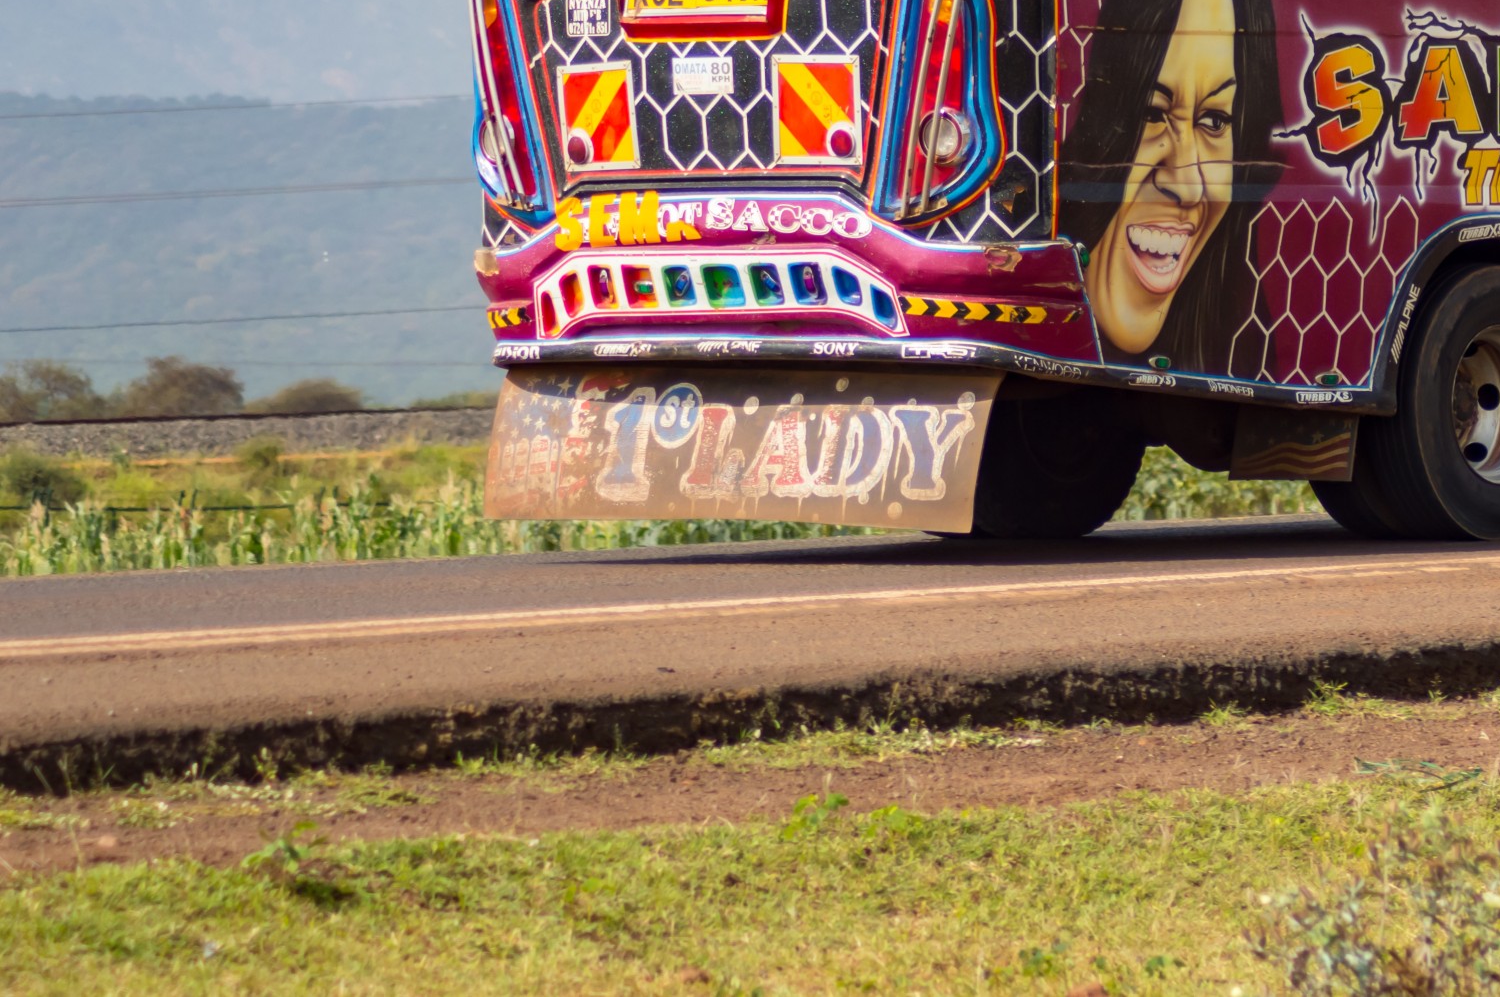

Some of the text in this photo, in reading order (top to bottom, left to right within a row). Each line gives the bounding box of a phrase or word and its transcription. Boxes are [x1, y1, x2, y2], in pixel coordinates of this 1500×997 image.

[675, 62, 730, 74] OMATA 80
[705, 197, 872, 239] SACCO
[813, 342, 859, 356] SONY
[680, 401, 975, 501] LADY
